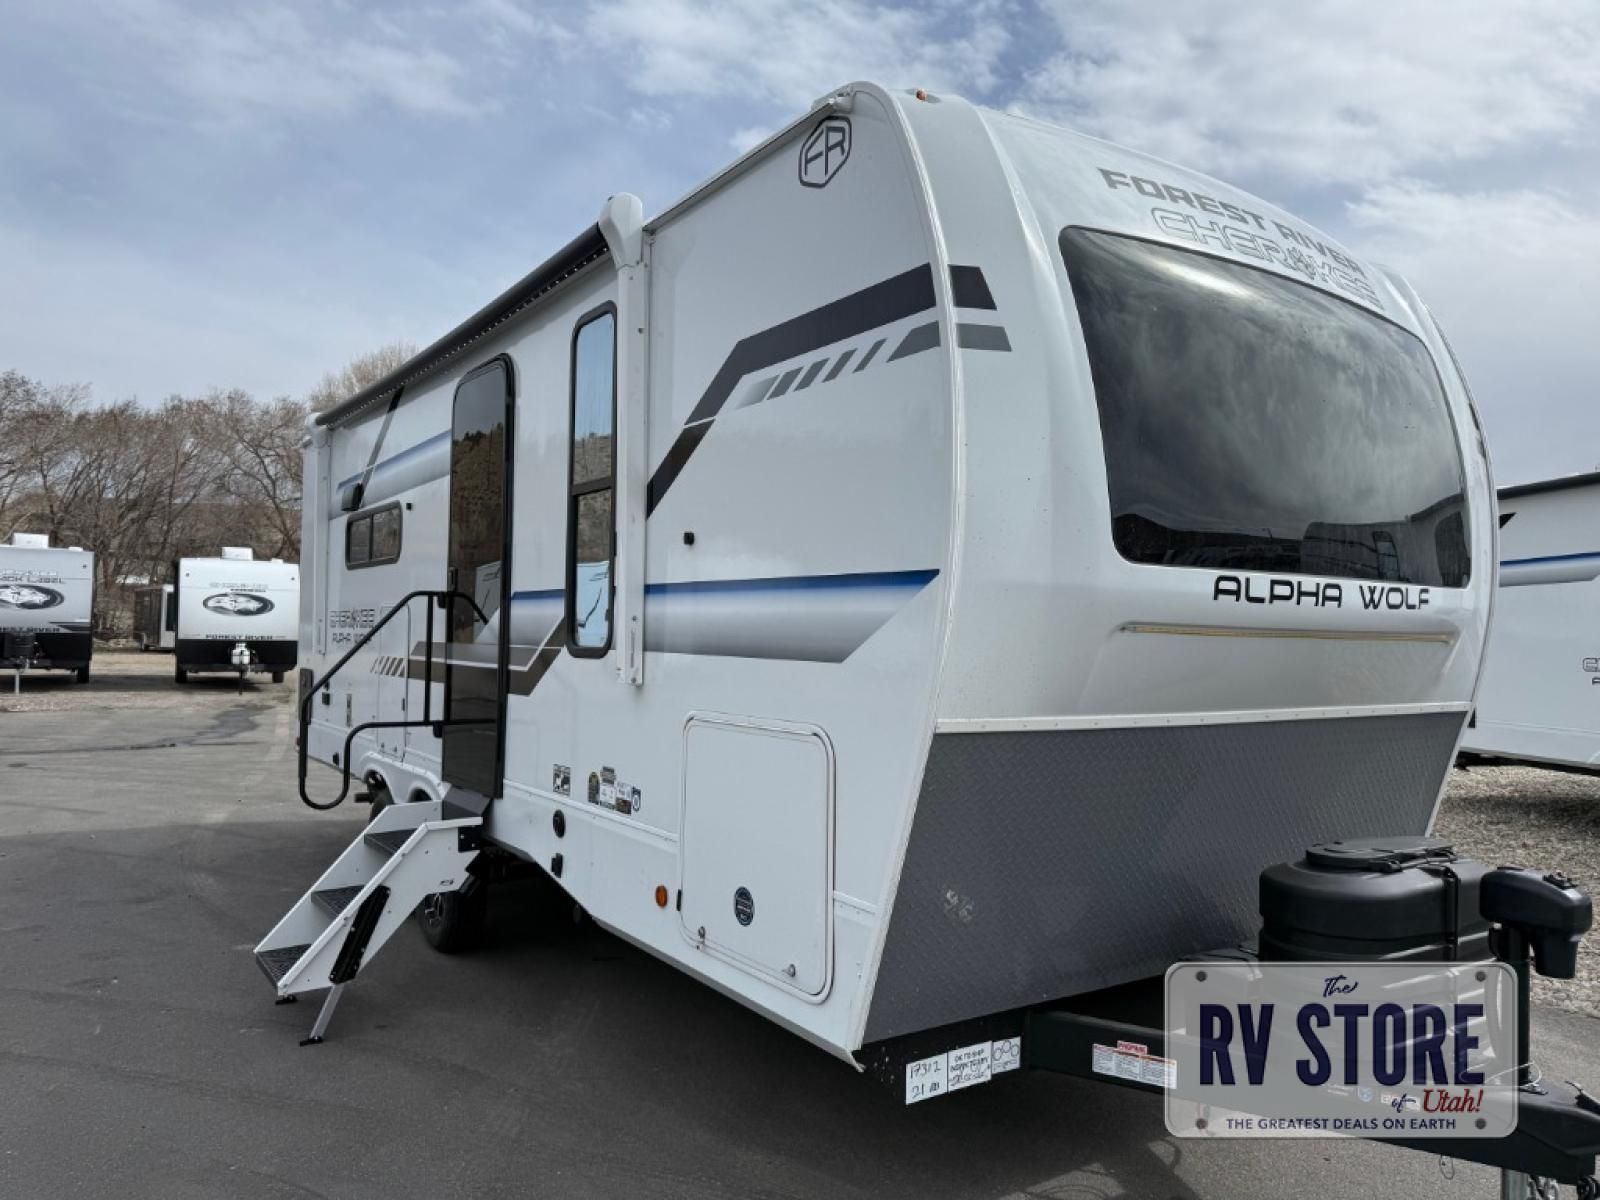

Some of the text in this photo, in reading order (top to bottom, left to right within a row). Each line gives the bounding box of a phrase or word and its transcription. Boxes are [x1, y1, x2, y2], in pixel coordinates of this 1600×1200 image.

[1096, 166, 1368, 279] FOREST RIVER
[1213, 575, 1430, 610] ALPHA WOLF
